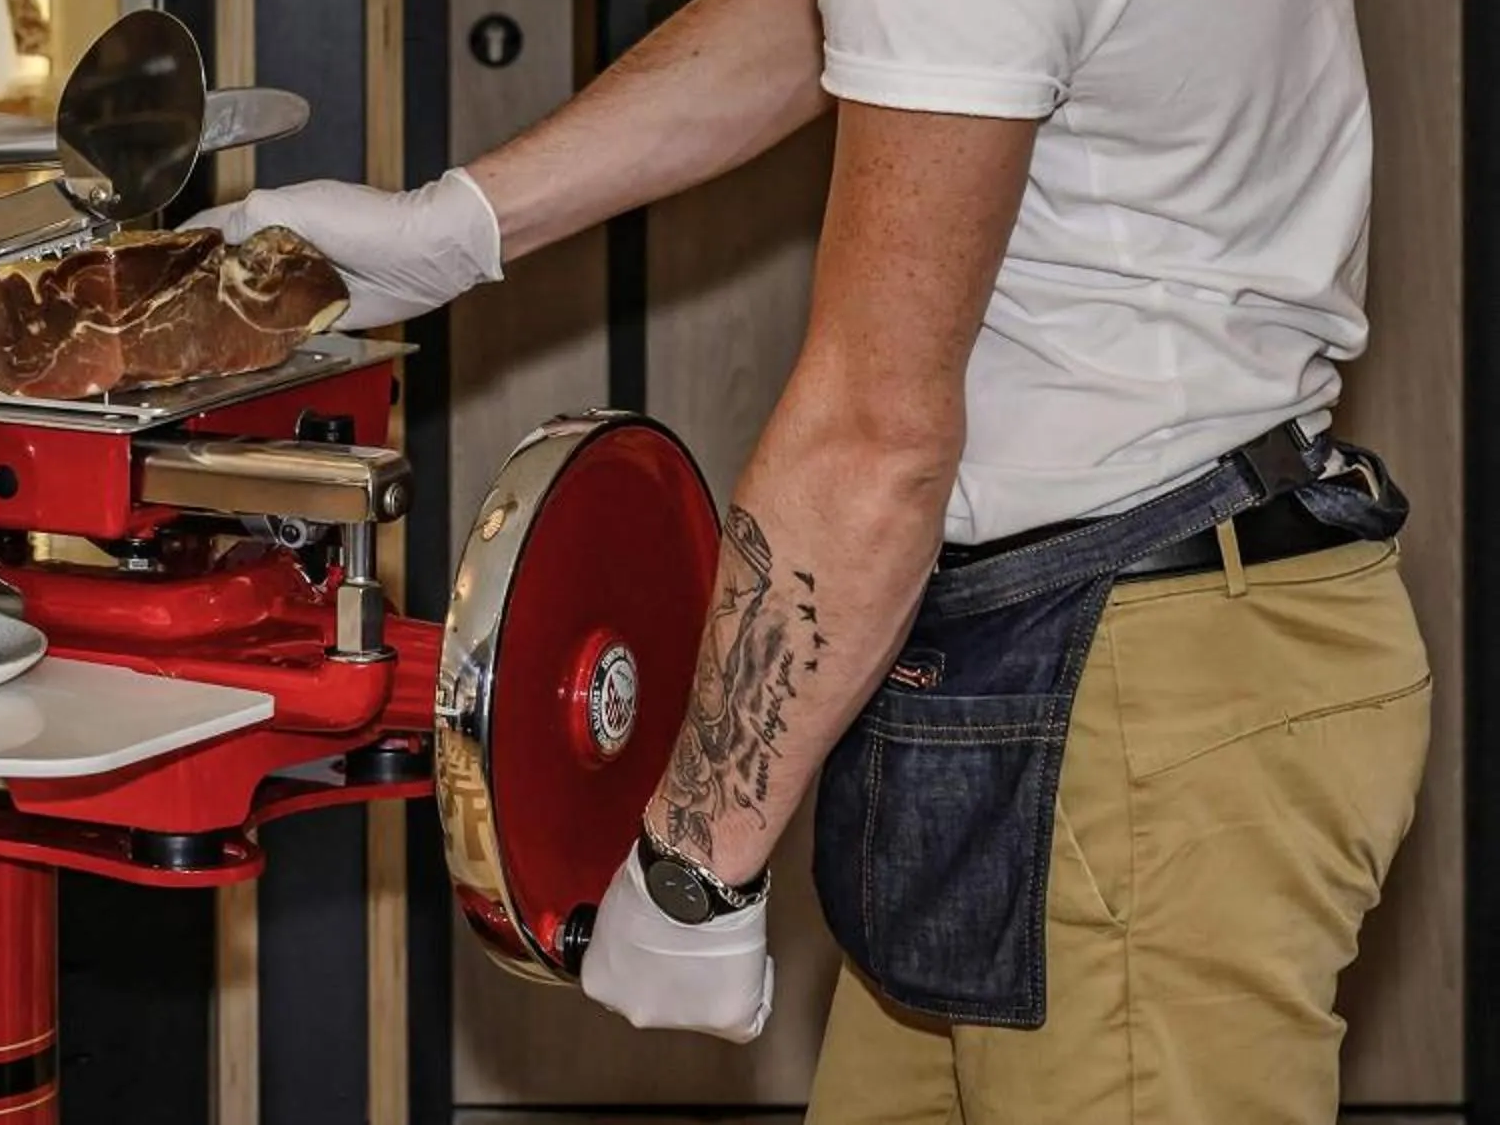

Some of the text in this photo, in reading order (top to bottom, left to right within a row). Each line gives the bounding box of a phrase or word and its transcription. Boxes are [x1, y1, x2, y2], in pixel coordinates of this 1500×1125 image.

[733, 649, 798, 831] I never forget you
